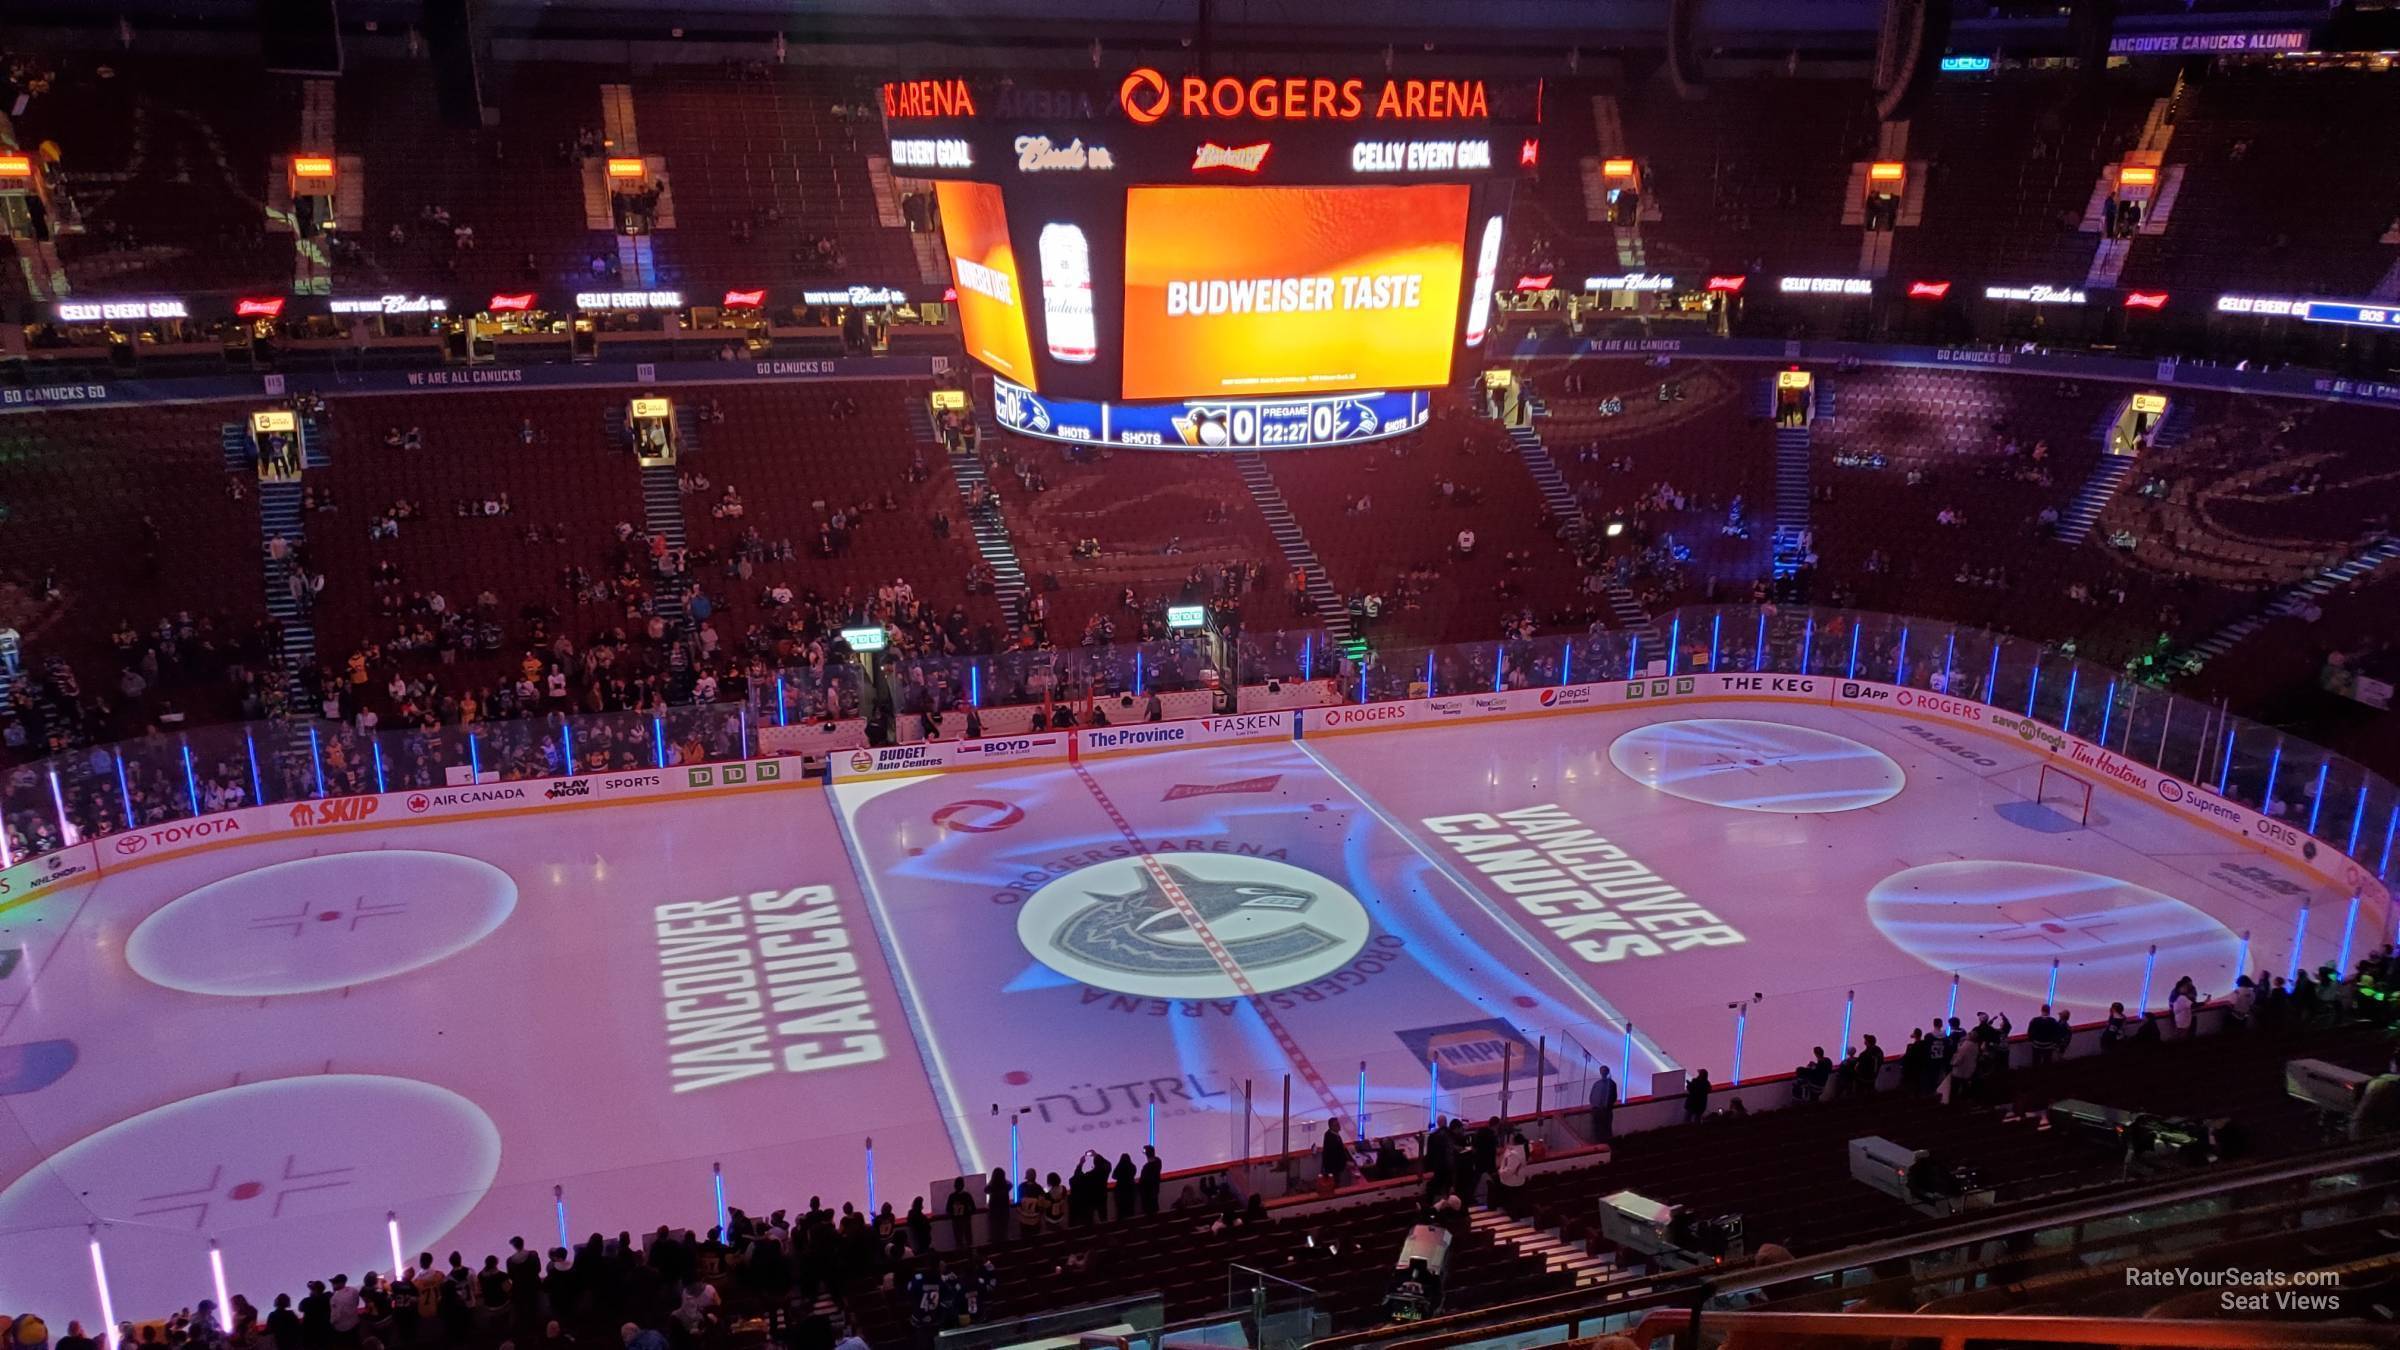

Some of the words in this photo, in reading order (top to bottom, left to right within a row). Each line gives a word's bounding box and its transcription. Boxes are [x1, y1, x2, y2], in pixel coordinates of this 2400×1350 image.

[2109, 36, 2178, 52] ANCOUVER
[2181, 34, 2245, 50] CANUCKS
[2249, 33, 2303, 48] ALUMNI
[900, 79, 975, 116] ARENA
[1183, 79, 1361, 118] ROGERS
[1376, 80, 1488, 118] ARENA
[1352, 142, 1406, 169] CELLY
[1408, 142, 1455, 169] EVERY
[1781, 278, 1811, 291] CELLY
[1811, 278, 1843, 292] EVERY
[576, 294, 609, 308] CELLY
[611, 293, 647, 308] EVERY
[1167, 279, 1331, 316] BUDWEISER
[1341, 274, 1422, 310] TASTE
[60, 305, 102, 319] CELLY
[103, 303, 146, 318] EVERY
[2218, 297, 2252, 311] CELLY
[2252, 299, 2290, 314] EVERY
[2359, 310, 2385, 322] BOS
[1591, 340, 1604, 351] WE
[1605, 340, 1621, 351] ARE
[1623, 340, 1638, 351] ALL
[1640, 340, 1680, 351] CANUCKS
[757, 363, 770, 374] GO
[774, 361, 818, 373] CANUCKS
[821, 360, 834, 372] GO
[1937, 350, 1949, 361] GO
[1952, 351, 1995, 363] CANUCKS
[1998, 353, 2011, 365] GO
[408, 373, 425, 385] WE
[428, 372, 448, 384] ARE
[451, 371, 469, 383] ALL
[472, 369, 522, 382] CANUCKS
[4, 390, 22, 402] GO
[25, 386, 85, 401] CANUCKS
[88, 385, 106, 398] GO
[1263, 406, 1308, 417] PREGAME
[1121, 432, 1161, 445] SHOTS
[1233, 410, 1254, 443] 0
[1263, 423, 1307, 442] 22:27
[1314, 407, 1332, 439] 0
[1384, 420, 1407, 433] SHOTS
[1058, 427, 1090, 440] SHOTS
[1559, 686, 1590, 700] pepsi
[1630, 684, 1641, 695] TD
[1653, 682, 1667, 694] TD
[1679, 680, 1693, 692] TD
[1722, 677, 1763, 690] THE
[1772, 678, 1814, 692] KEG
[1345, 706, 1405, 722] ROGERS
[1917, 695, 1981, 720] ROGERS
[1214, 714, 1281, 732] FASKEN
[1992, 714, 2018, 731] save
[2020, 724, 2035, 736] on
[2037, 727, 2066, 750] foods
[984, 741, 1030, 752] BOYD
[1089, 733, 1117, 747] The
[1119, 728, 1184, 745] Province
[1901, 725, 1997, 767] PANAGO
[879, 747, 927, 761] BUDGET
[877, 760, 901, 771] Auto
[902, 757, 943, 768] Centres
[2072, 741, 2094, 766] Tim
[2095, 756, 2147, 790] Hortons
[605, 776, 660, 789] SPORTS
[693, 770, 710, 784] TD
[727, 768, 744, 781] TD
[759, 765, 777, 778] TD
[553, 780, 589, 789] PLAY
[554, 787, 589, 797] NOW
[433, 793, 458, 806] AIR
[461, 788, 525, 804] CANADA
[317, 796, 379, 824] SKIP
[2186, 791, 2241, 823] Supreme
[152, 818, 239, 846] TOYOTA
[2257, 819, 2297, 847] ORIS
[1156, 839, 1288, 860] ARENA
[1497, 804, 1746, 951] VANCOUVER
[1422, 813, 1664, 963] CANUCKS
[749, 885, 886, 1072] CANUCKS
[654, 896, 775, 1093] VANCOUVER
[1437, 1040, 1514, 1065] NAPA
[920, 1292, 939, 1312] 43
